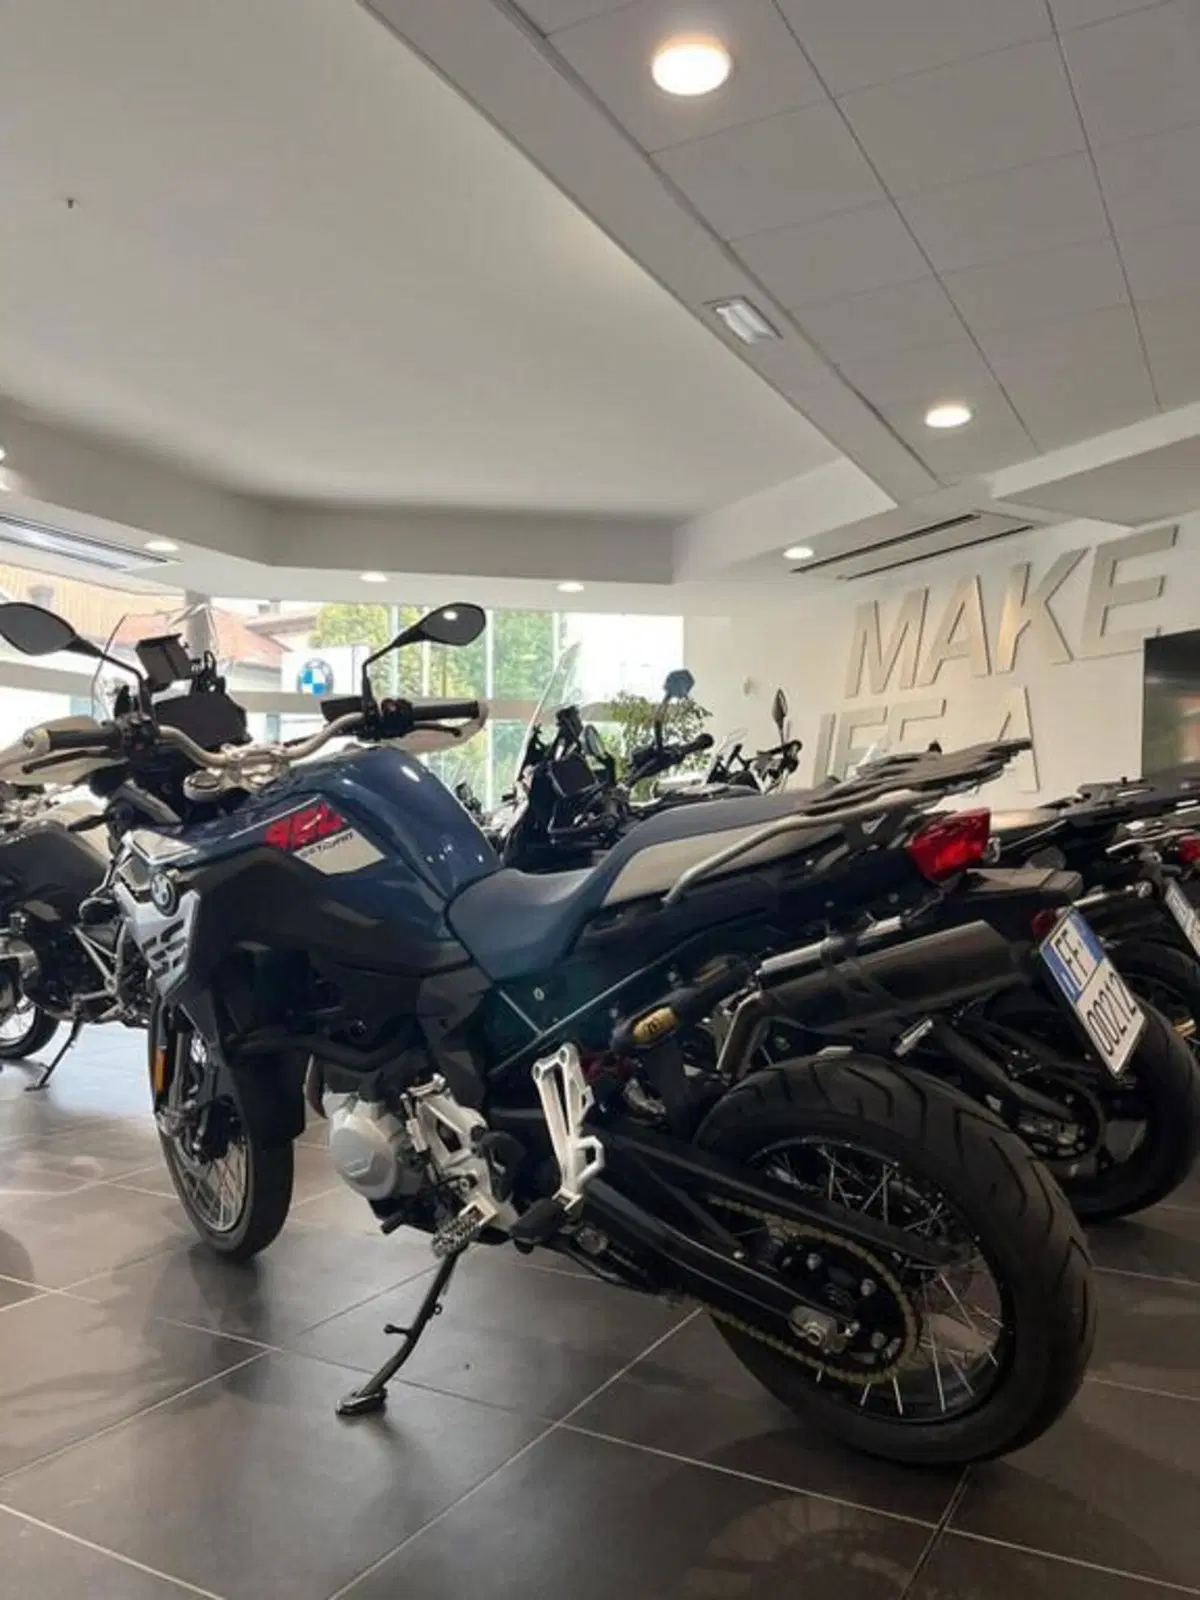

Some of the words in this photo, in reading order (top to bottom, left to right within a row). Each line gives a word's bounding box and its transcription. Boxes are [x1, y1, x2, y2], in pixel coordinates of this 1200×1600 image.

[846, 525, 1178, 698] MAKE
[1056, 930, 1089, 988] FF
[1086, 972, 1137, 1056] 00212
